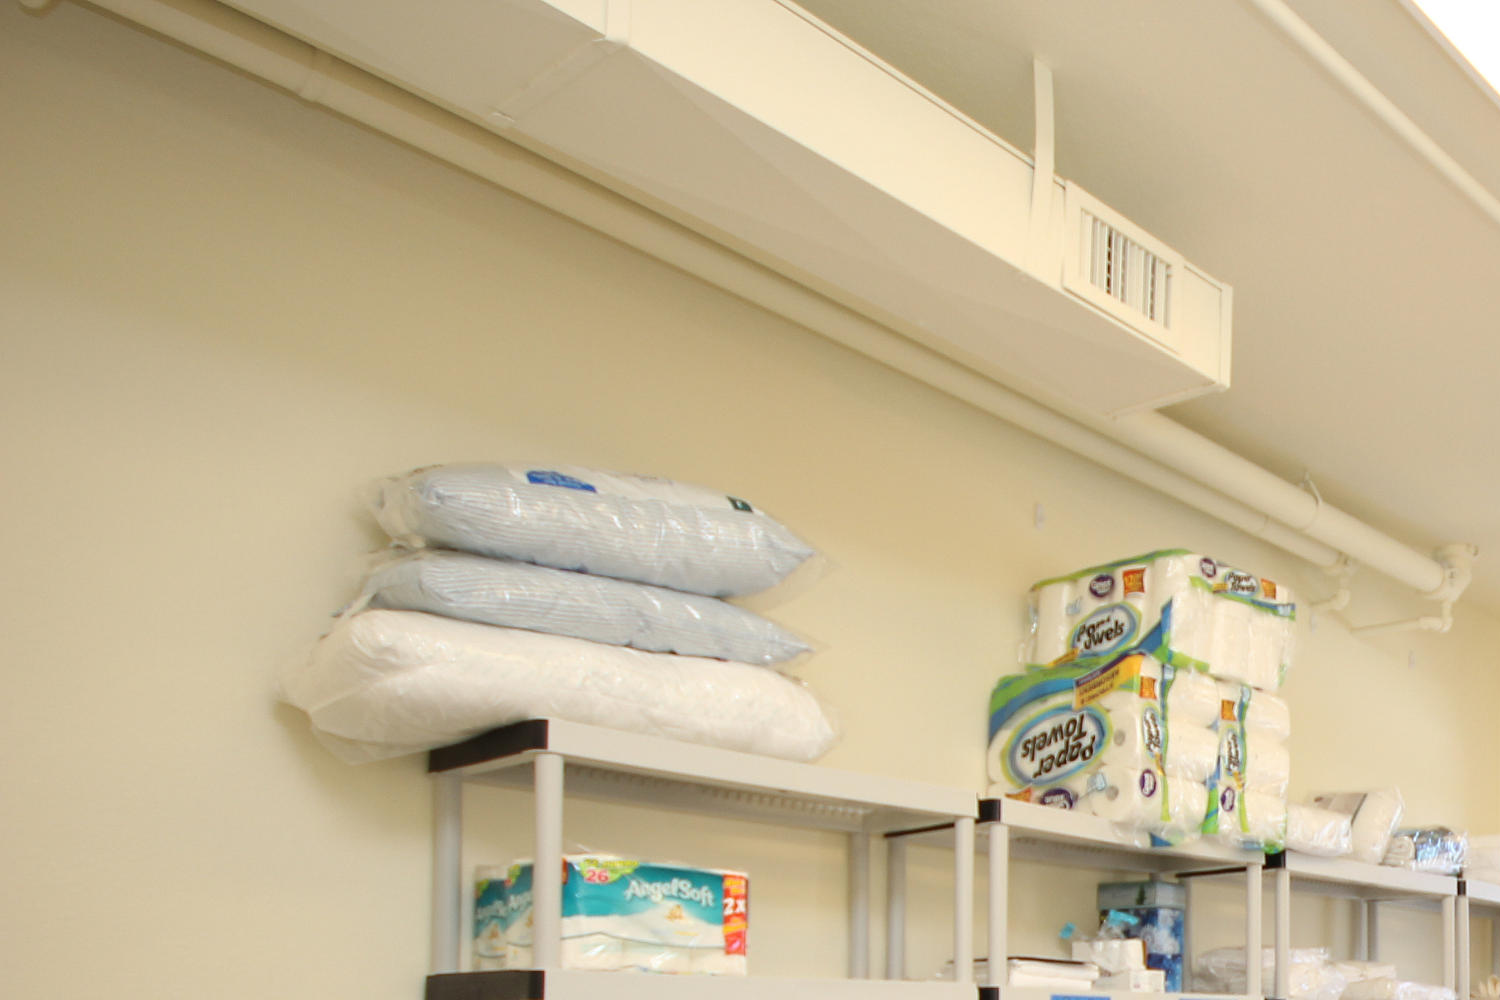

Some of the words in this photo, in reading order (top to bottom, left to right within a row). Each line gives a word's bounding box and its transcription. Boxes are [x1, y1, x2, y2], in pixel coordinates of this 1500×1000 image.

[1020, 713, 1088, 762] Towels
[1032, 735, 1096, 779] Paper
[585, 868, 610, 883] 26
